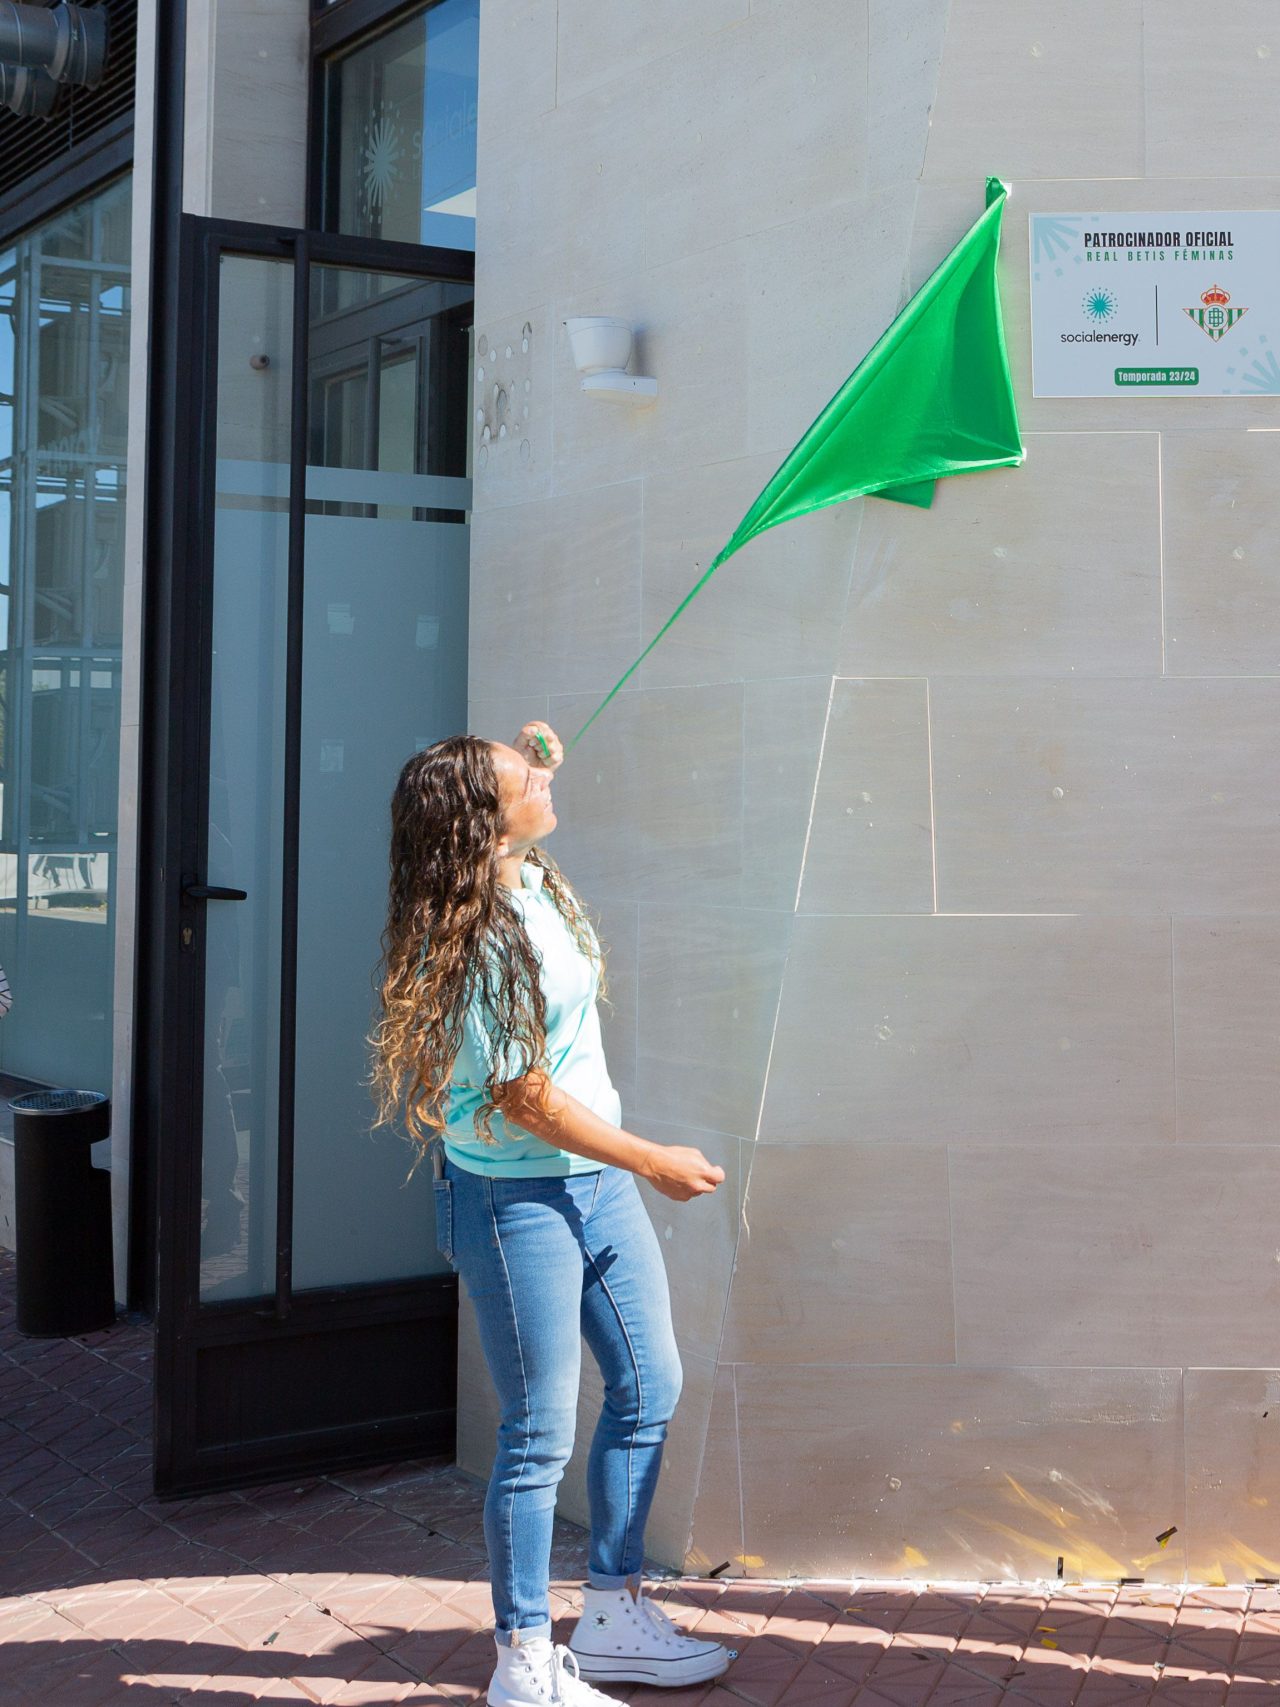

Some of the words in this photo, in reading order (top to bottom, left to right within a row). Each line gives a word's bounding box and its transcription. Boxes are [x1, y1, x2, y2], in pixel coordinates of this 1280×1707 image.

[1083, 231, 1181, 247] PATROCINADOR
[1185, 231, 1234, 247] OFICIAL
[1086, 251, 1118, 262] REAL
[1127, 250, 1165, 262] BETIS
[1174, 248, 1234, 261] FÉMINAS
[1060, 329, 1139, 346] socialenergy
[1118, 371, 1167, 383] Temporada
[1169, 371, 1195, 382] 23/24
